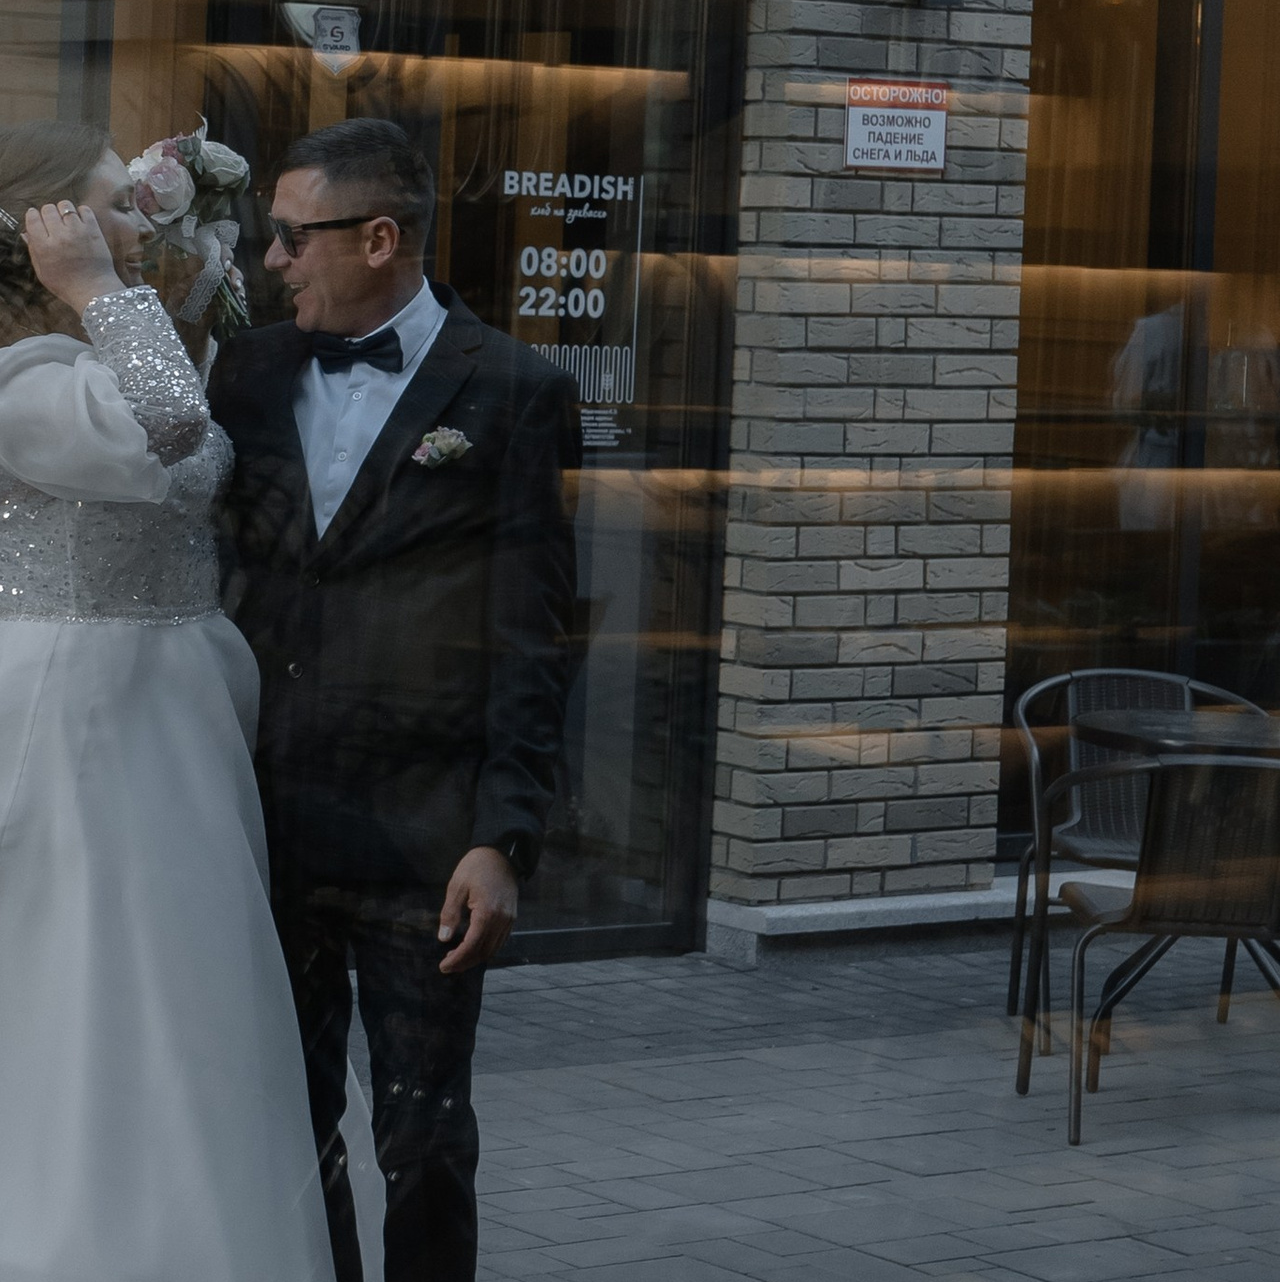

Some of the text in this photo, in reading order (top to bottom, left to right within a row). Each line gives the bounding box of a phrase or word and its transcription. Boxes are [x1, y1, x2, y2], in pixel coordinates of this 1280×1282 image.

[850, 85, 947, 104] ОСТОРОЖНО!
[862, 114, 931, 128] ВОЗМОЖНО
[867, 131, 924, 146] ПАДЕНИЕ
[852, 147, 937, 164] СНЕГА И ЛЬДА
[503, 170, 634, 201] BREADISH
[520, 245, 607, 279] 08:00
[518, 285, 606, 318] 22:00
